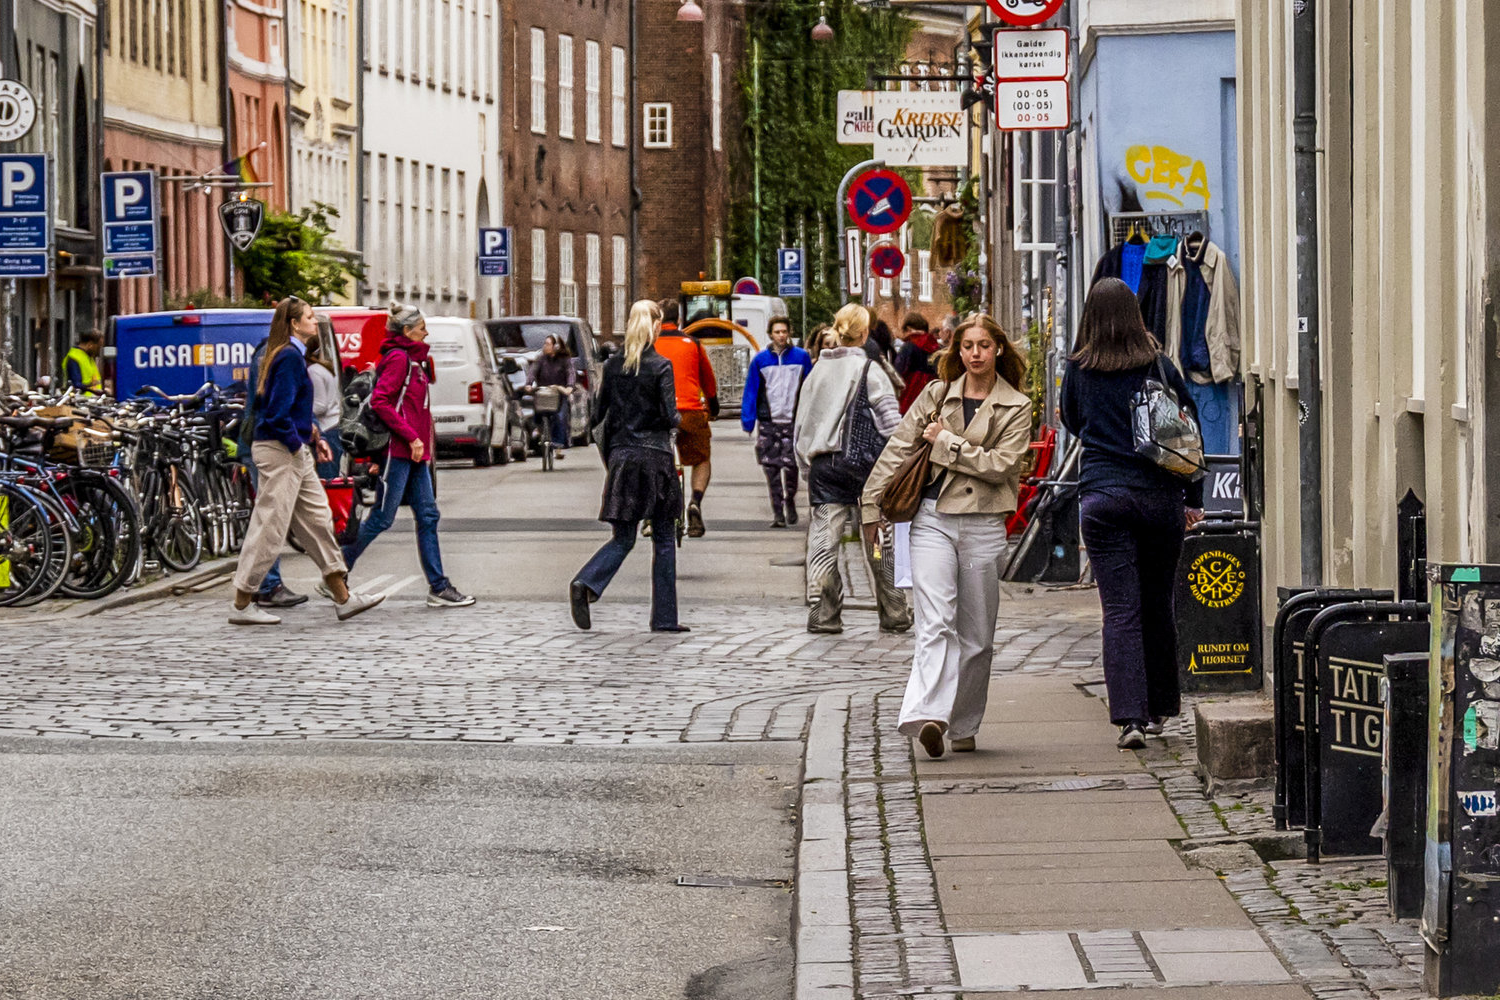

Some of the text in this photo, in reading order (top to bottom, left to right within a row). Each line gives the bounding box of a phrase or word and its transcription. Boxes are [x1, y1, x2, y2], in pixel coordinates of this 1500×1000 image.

[1016, 40, 1047, 48] Gælder
[1001, 50, 1062, 59] ikkenødvendig
[893, 108, 964, 126] KREBSE
[877, 118, 961, 142] GAARDEN
[2, 161, 36, 208] P
[114, 178, 144, 218] P
[484, 230, 503, 255] P
[784, 251, 798, 270] P
[134, 344, 191, 369] CASA
[1190, 550, 1242, 570] COPENHAGEN
[1210, 561, 1222, 573] C
[1207, 582, 1244, 608] EXTREMES
[1197, 643, 1250, 653] RUNDT OM
[1202, 655, 1246, 665] HJØRNET
[1330, 708, 1381, 748] TIG
